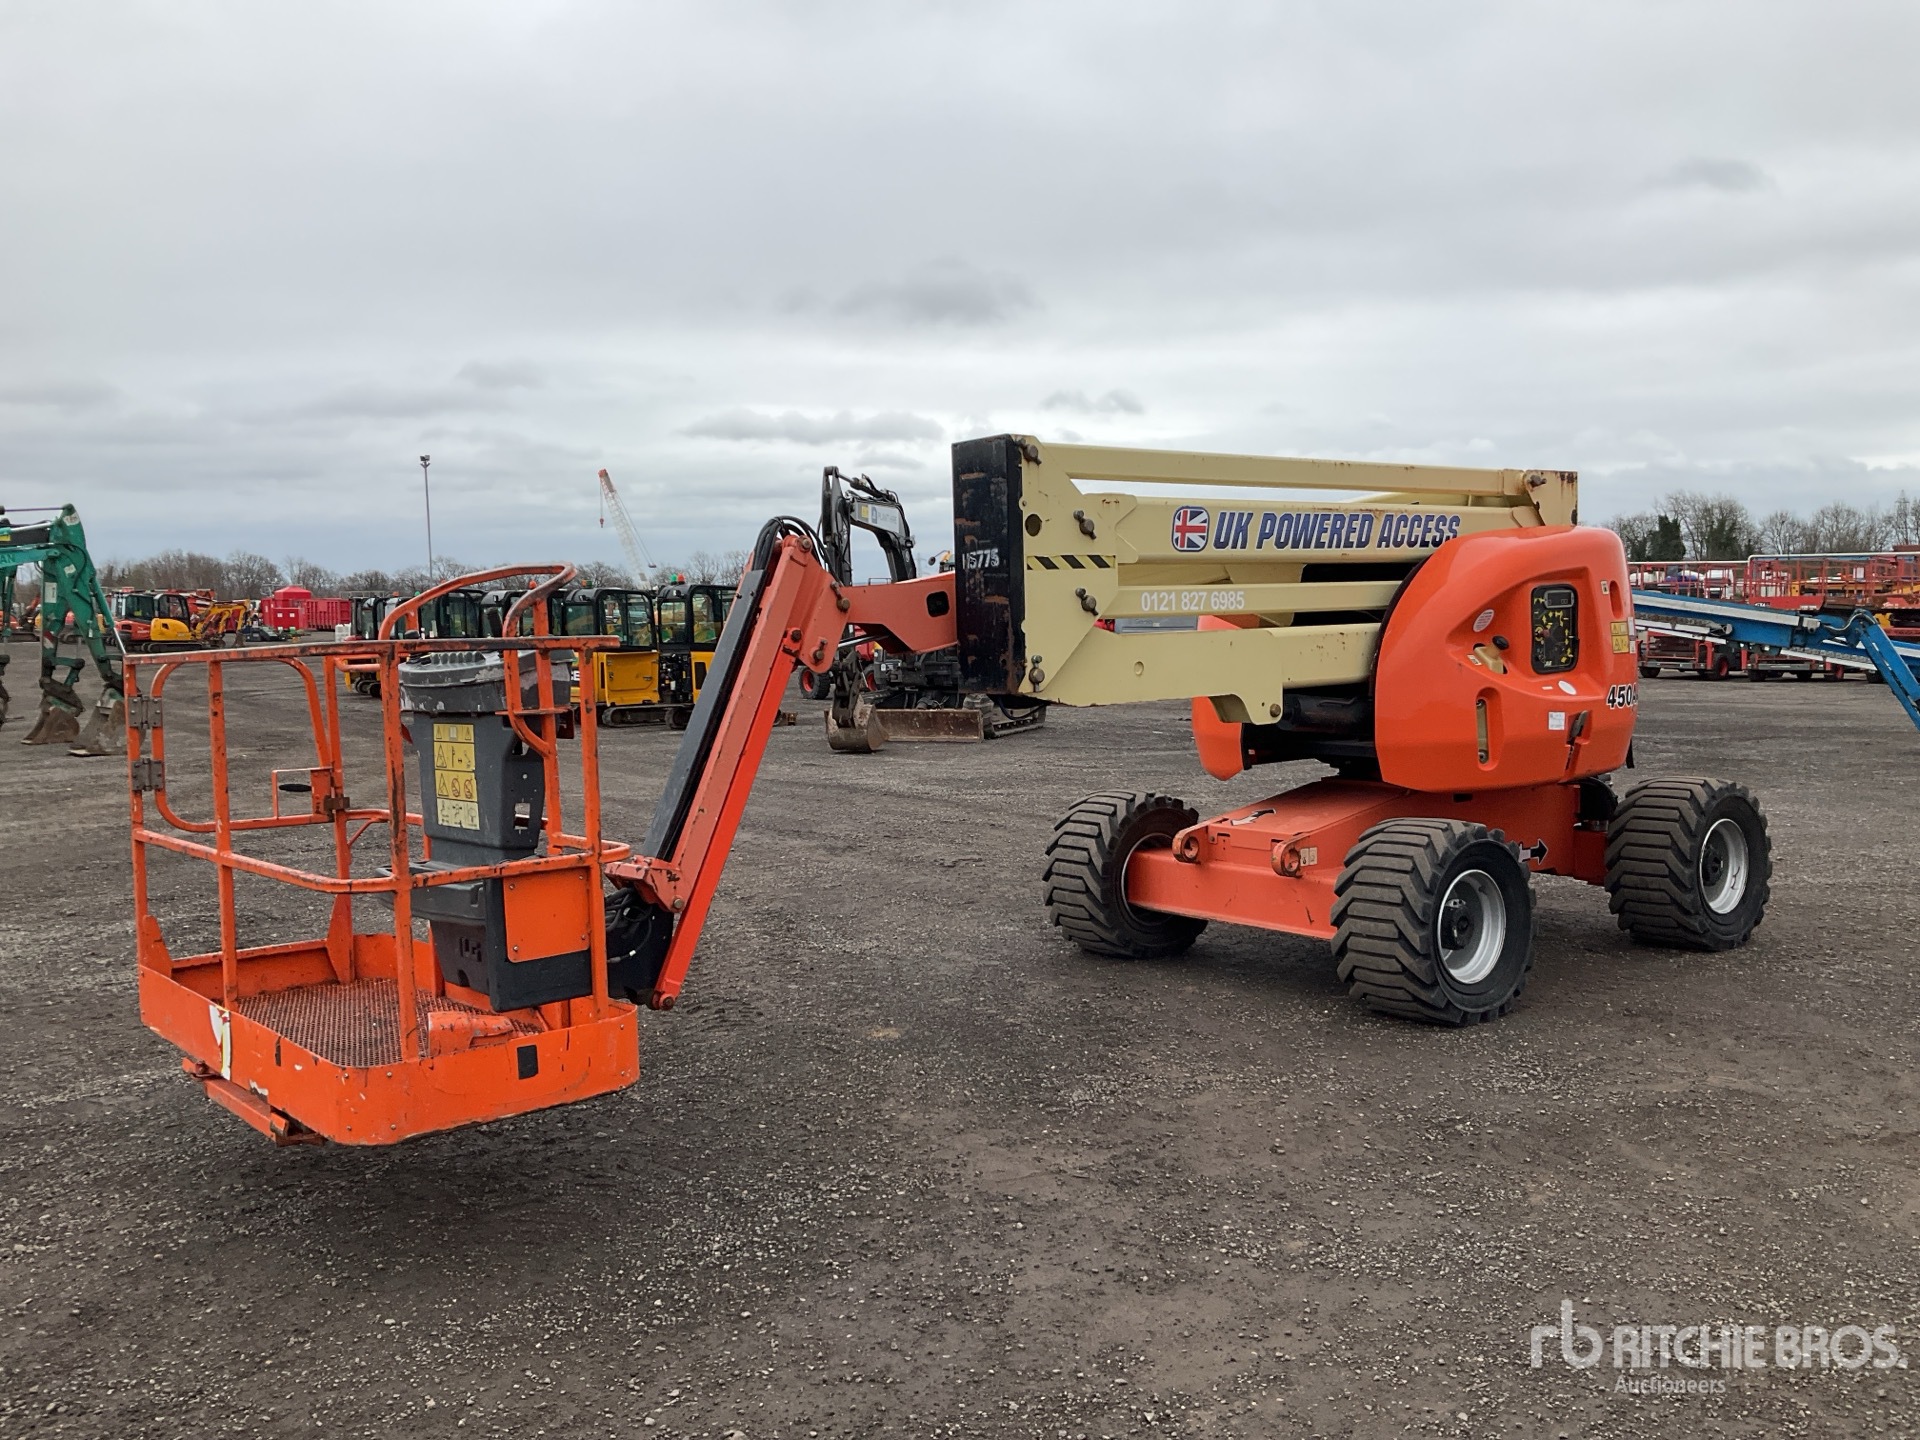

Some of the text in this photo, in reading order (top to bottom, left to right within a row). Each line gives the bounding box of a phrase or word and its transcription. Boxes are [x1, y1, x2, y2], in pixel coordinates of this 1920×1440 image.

[1213, 511, 1461, 550] UK POWERED ACCESS
[1141, 591, 1245, 611] 0121 827 6985
